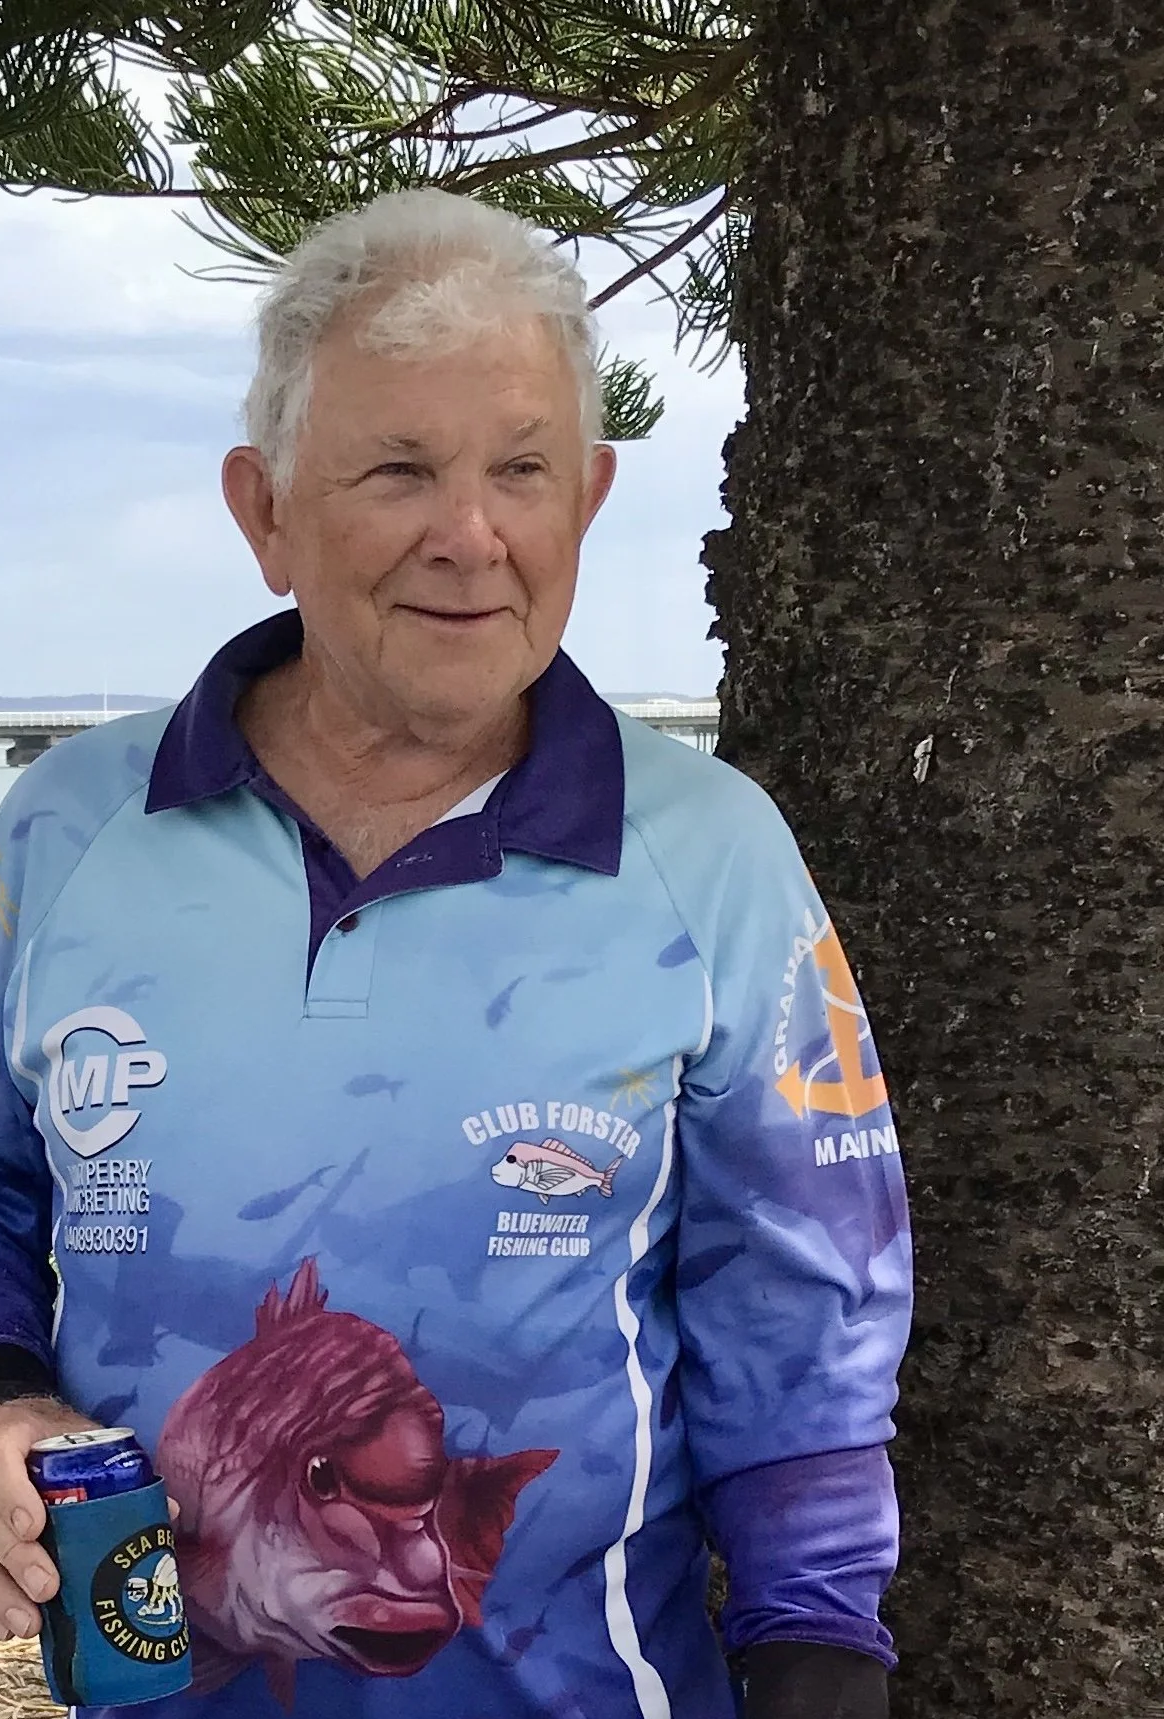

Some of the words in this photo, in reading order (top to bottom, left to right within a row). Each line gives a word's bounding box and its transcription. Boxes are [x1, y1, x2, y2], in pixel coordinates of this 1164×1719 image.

[462, 1102, 540, 1146] CLUB
[547, 1101, 642, 1160] FORSTER
[86, 1160, 153, 1188] PERRY
[66, 1187, 151, 1213] CRETING
[496, 1211, 590, 1233] BLUEWATER
[487, 1236, 548, 1256] FISHING
[550, 1237, 591, 1256] CLUB
[113, 1535, 153, 1569] SEA
[156, 1529, 175, 1549] BE
[96, 1599, 166, 1661] FISHING
[170, 1617, 190, 1657] CL
